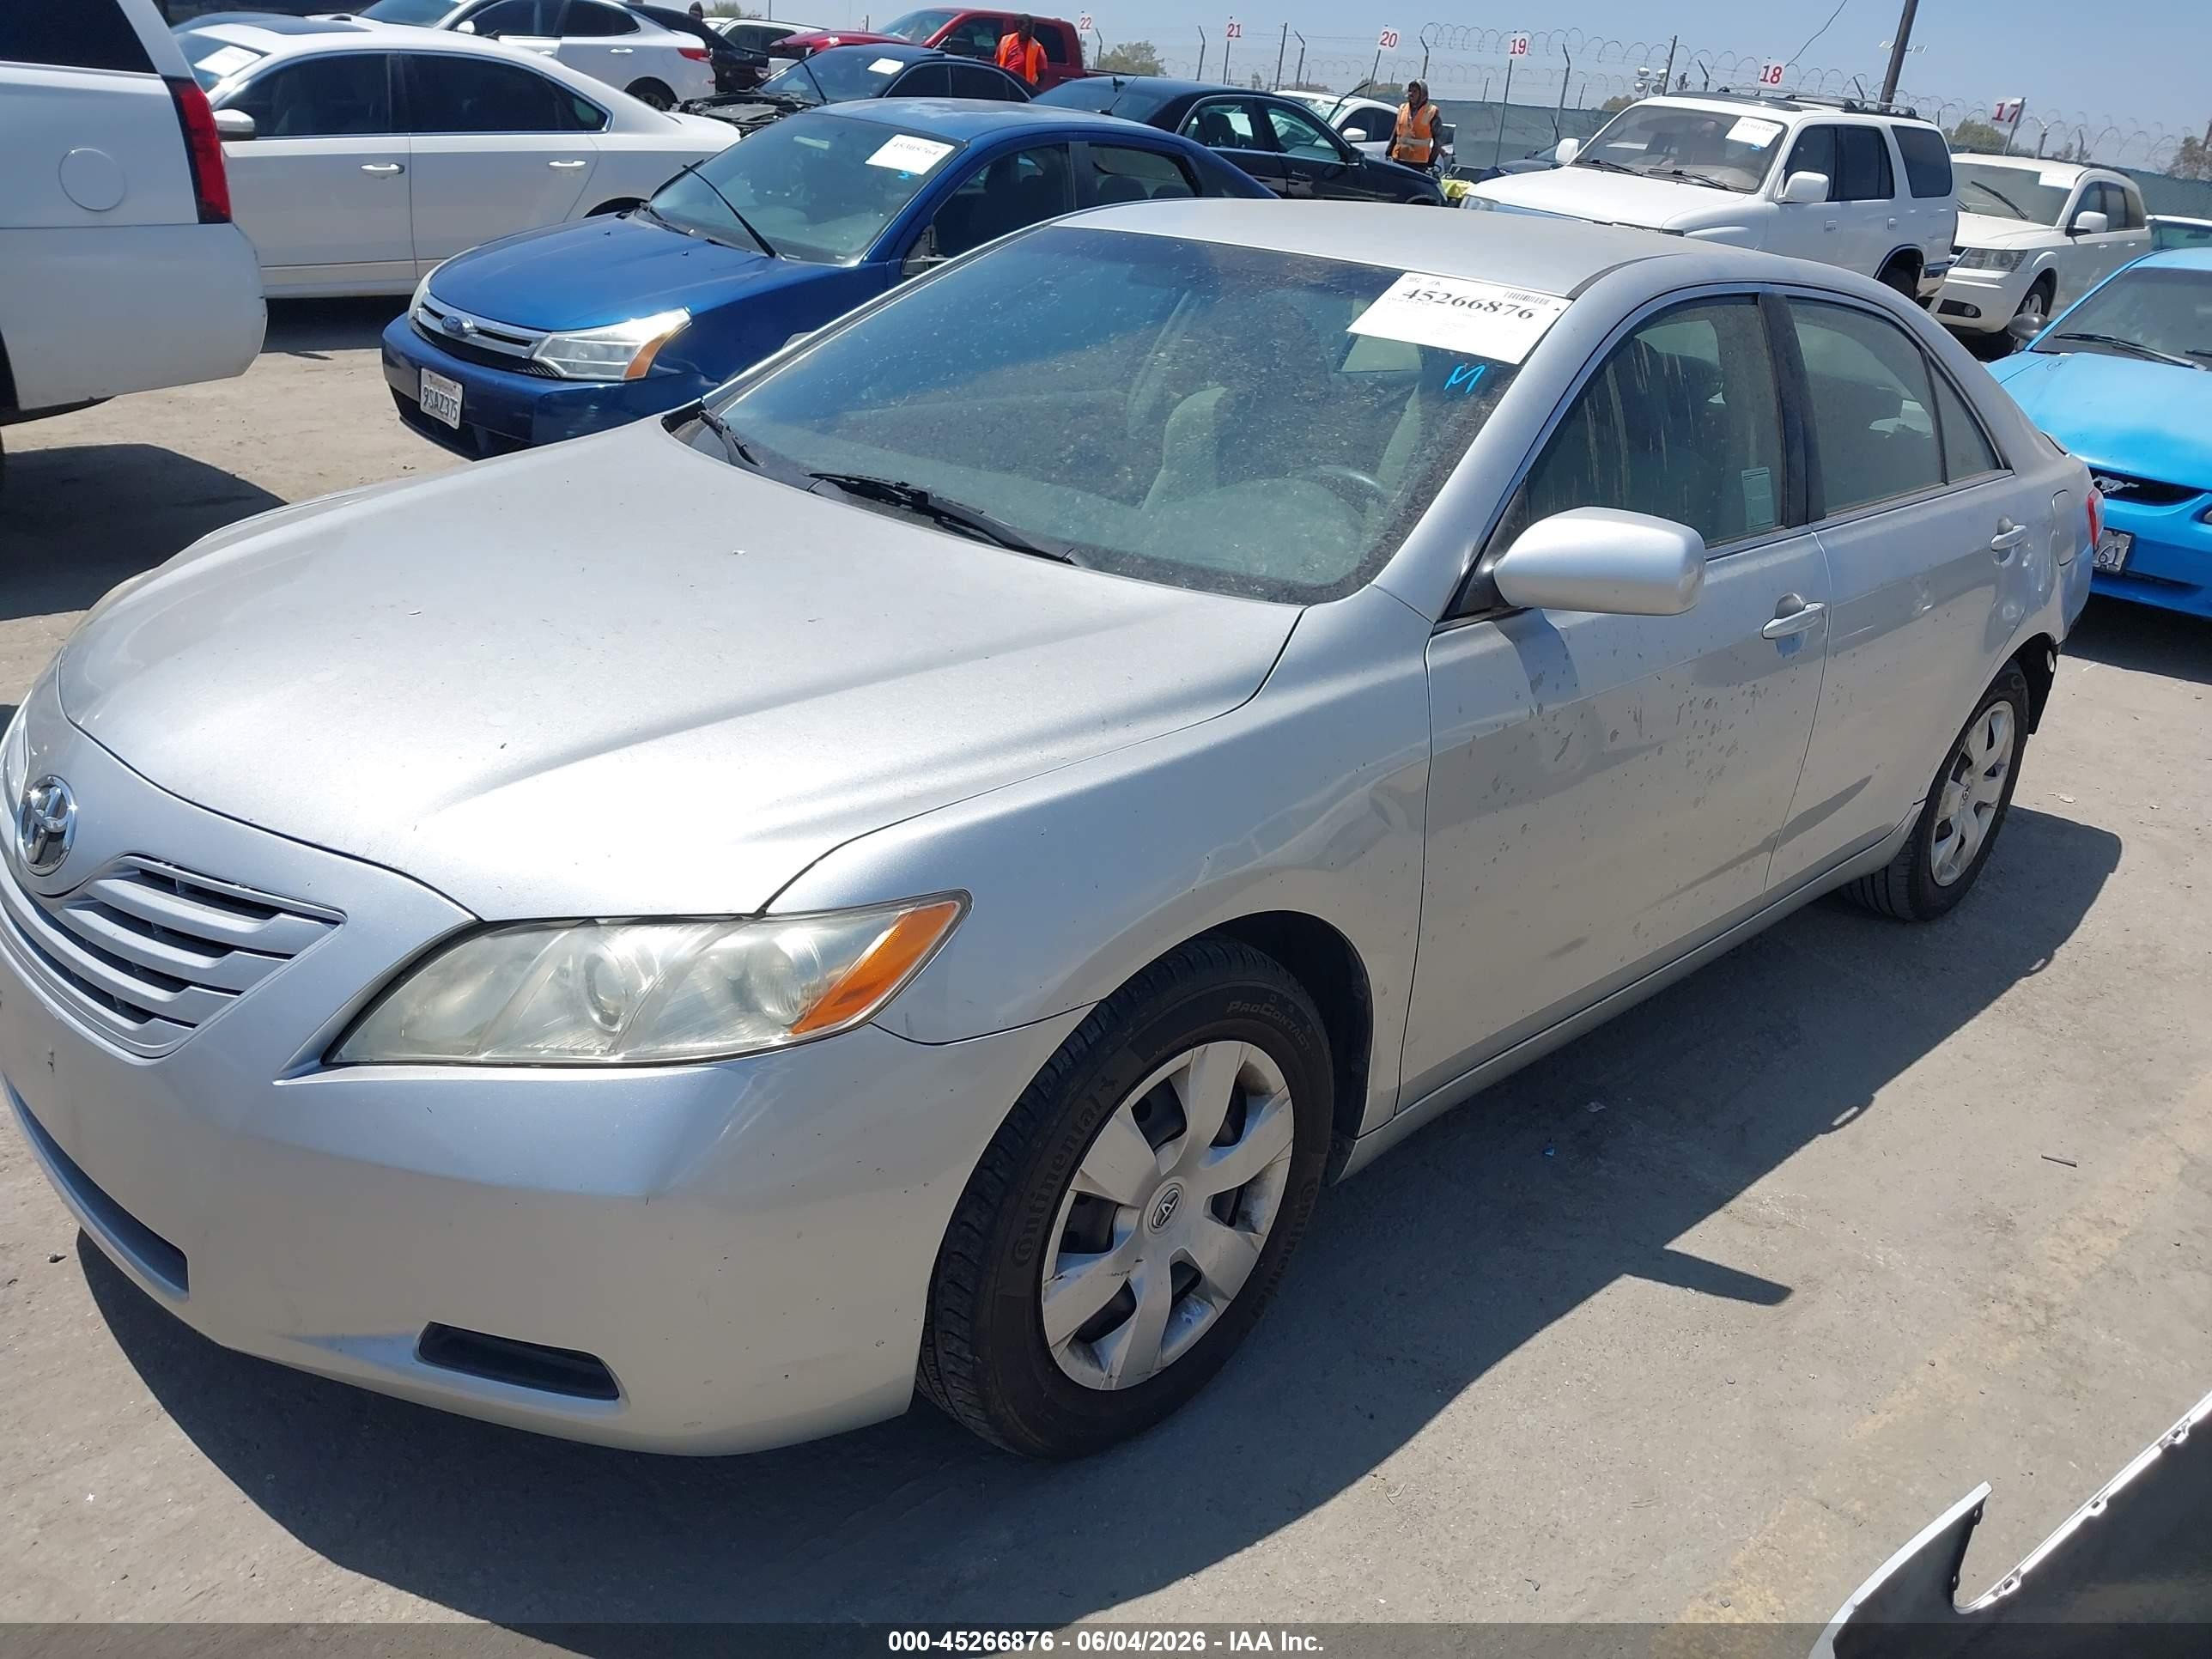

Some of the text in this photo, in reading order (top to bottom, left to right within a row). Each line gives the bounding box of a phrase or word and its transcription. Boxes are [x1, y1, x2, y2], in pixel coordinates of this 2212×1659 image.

[1079, 16, 1092, 30] 22
[1226, 22, 1242, 38] 21
[1379, 31, 1398, 48] 20
[1510, 38, 1527, 55] 19
[1759, 64, 1783, 84] 18
[1991, 102, 2021, 123] 17
[1402, 288, 1538, 320] 45266876
[1012, 1092, 1103, 1268] Continental
